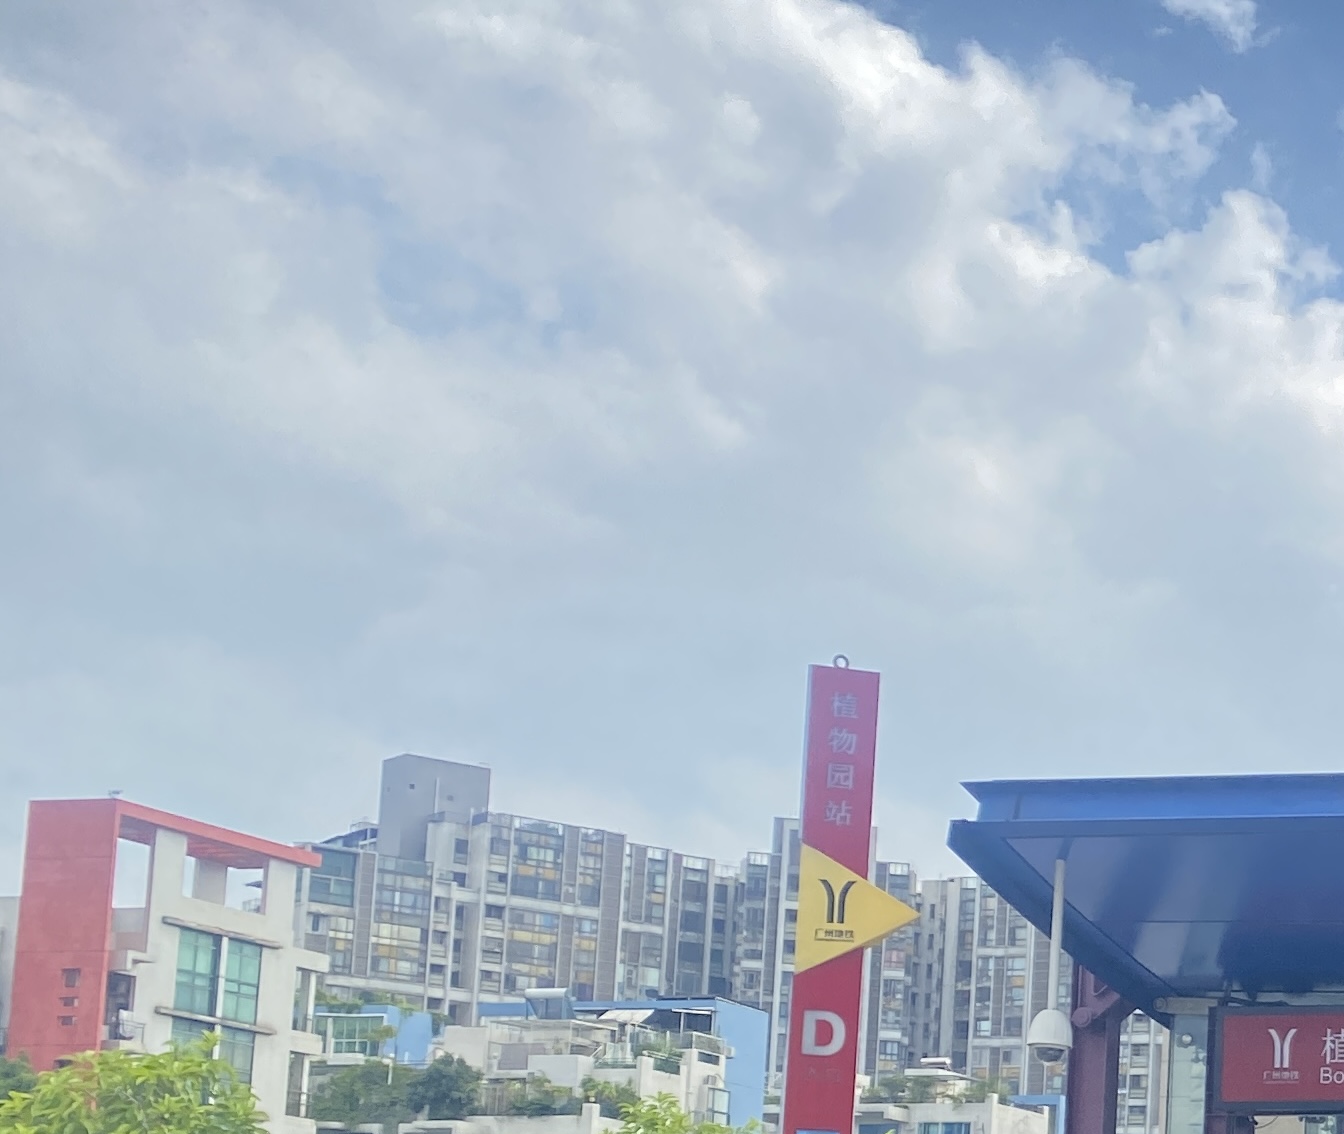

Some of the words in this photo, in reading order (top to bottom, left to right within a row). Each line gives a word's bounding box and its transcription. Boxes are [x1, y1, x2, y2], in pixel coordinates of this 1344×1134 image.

[824, 690, 860, 827] 植物园站
[801, 1010, 846, 1056] D
